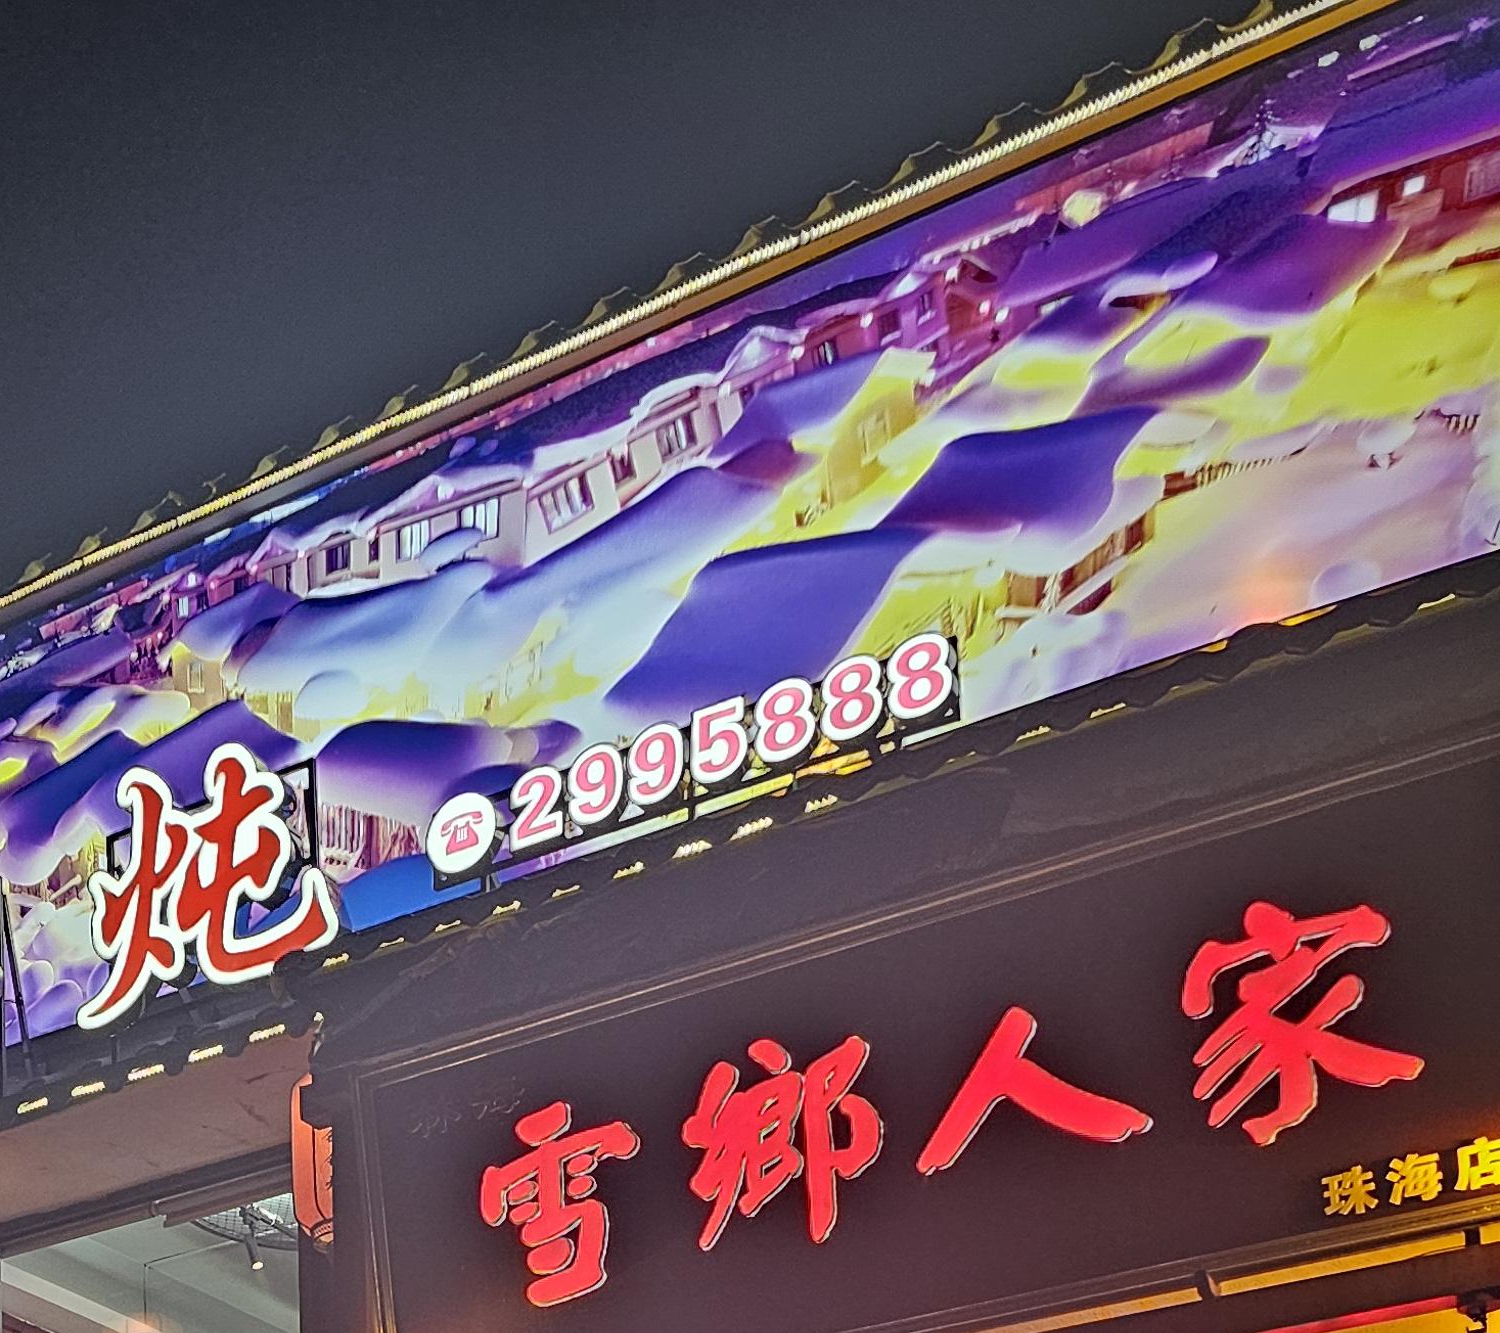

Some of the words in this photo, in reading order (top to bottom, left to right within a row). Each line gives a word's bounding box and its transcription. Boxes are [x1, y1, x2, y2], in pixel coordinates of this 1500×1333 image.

[509, 631, 956, 853] 2995888
[1321, 1137, 1500, 1217] 珠海店
